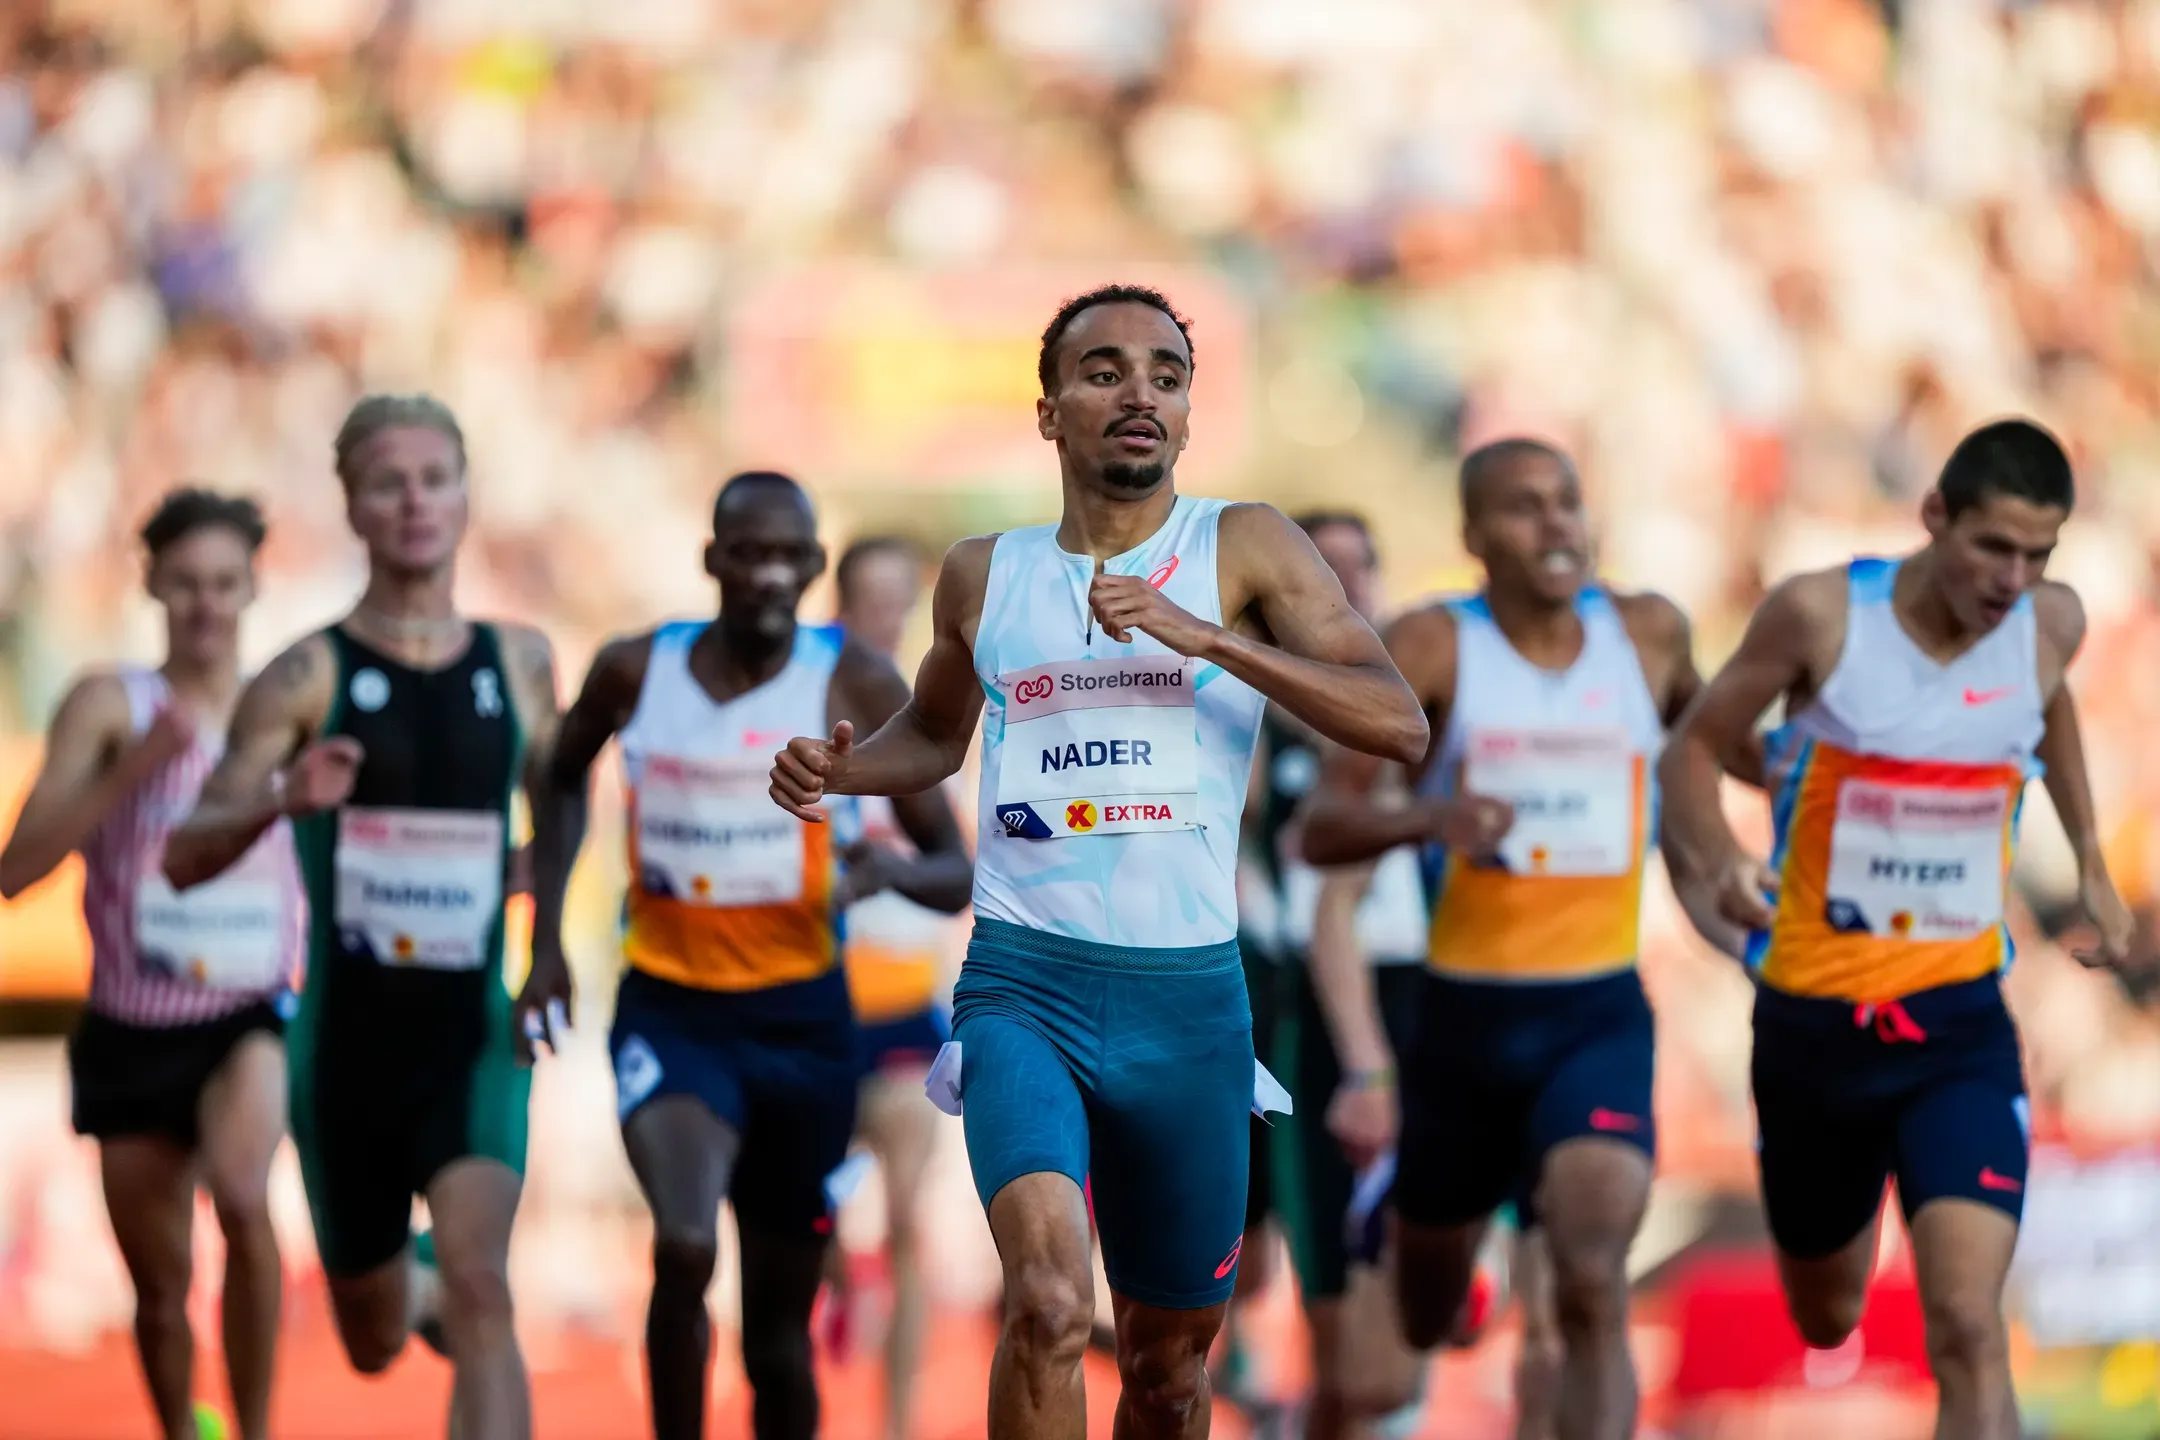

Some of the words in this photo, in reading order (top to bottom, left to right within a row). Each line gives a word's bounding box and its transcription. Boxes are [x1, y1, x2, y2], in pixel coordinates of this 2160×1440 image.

[1060, 668, 1183, 691] Storebrand
[1040, 739, 1153, 774] NADER
[1104, 804, 1173, 822] EXTRA
